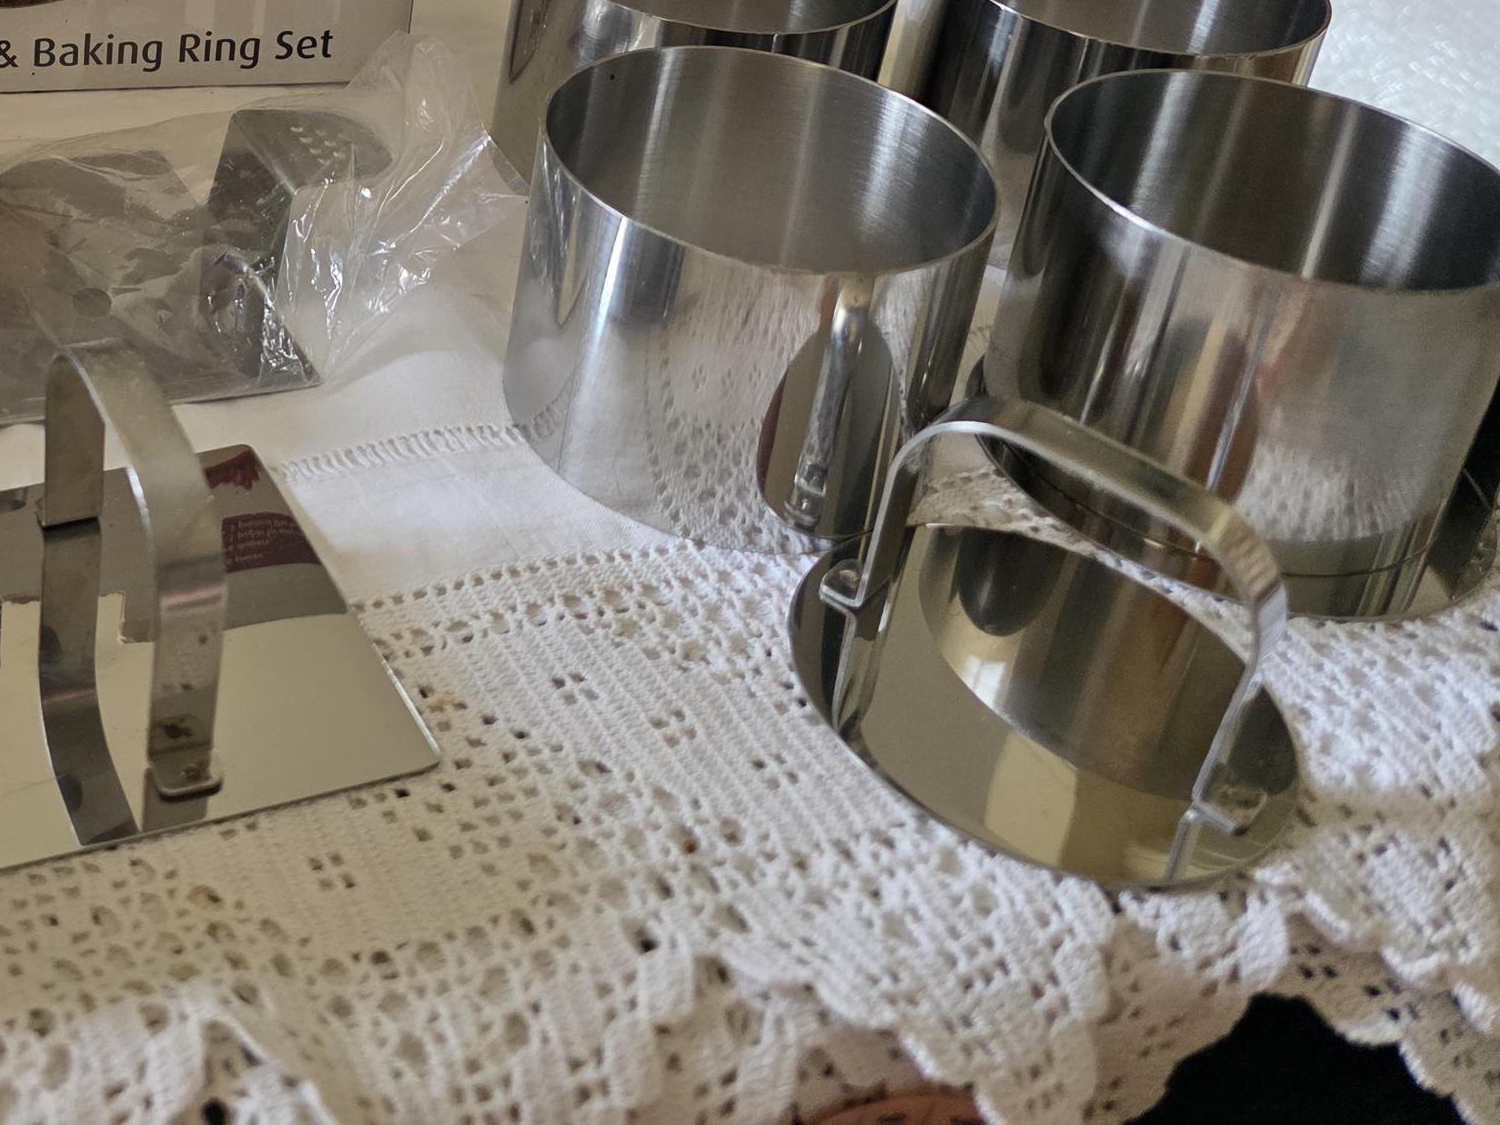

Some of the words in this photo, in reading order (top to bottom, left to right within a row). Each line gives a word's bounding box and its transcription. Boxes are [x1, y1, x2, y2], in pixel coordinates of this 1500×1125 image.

[33, 33, 163, 73] Baking
[178, 30, 261, 70] Ring
[274, 29, 334, 61] Set
